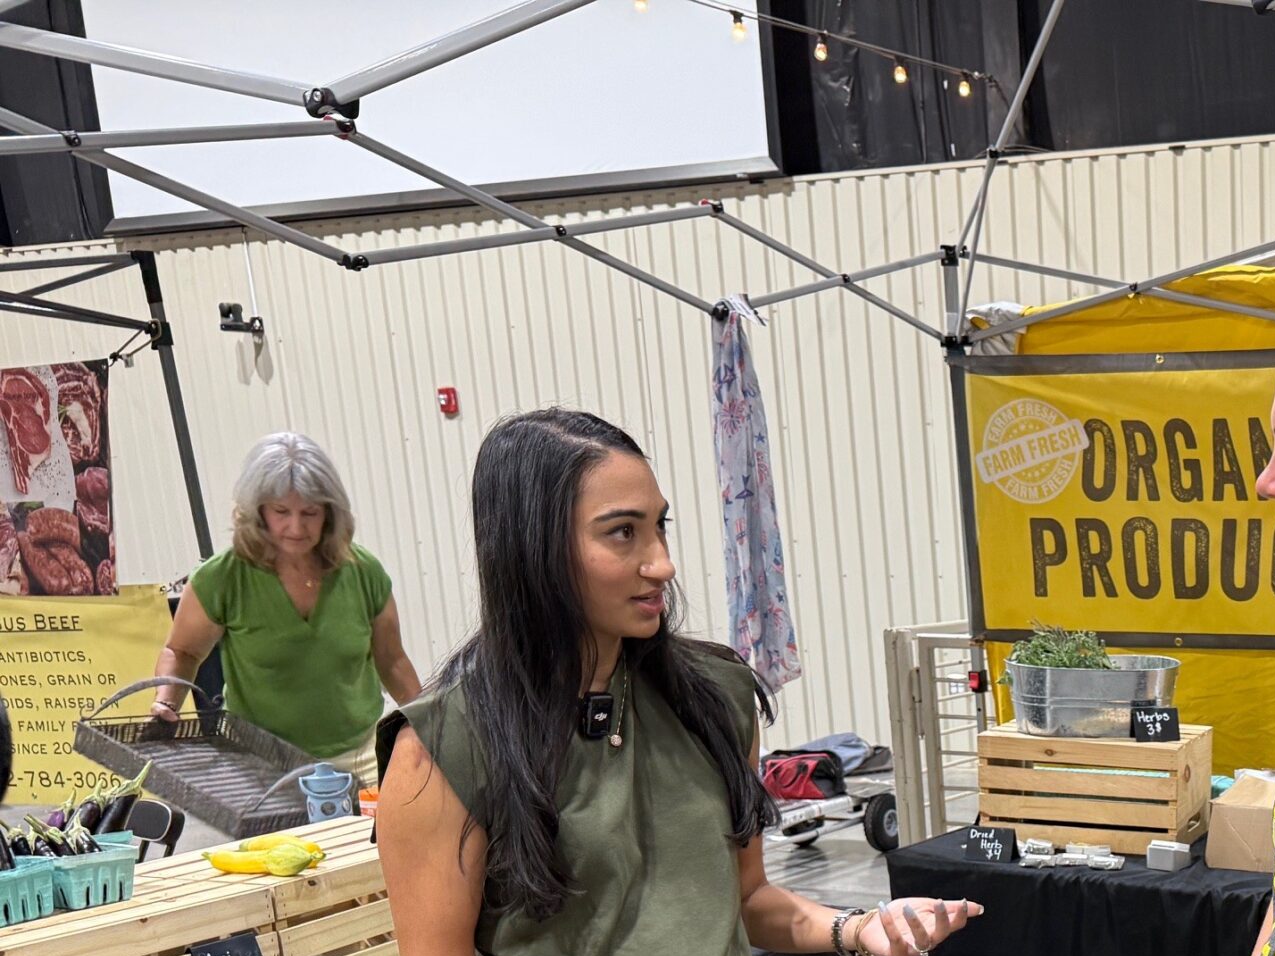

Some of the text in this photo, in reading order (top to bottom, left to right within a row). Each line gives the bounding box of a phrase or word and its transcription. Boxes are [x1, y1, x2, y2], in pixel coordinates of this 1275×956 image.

[983, 425, 1080, 478] FARM FRESH
[47, 674, 92, 686] GRAIN
[97, 673, 117, 686] OR
[44, 697, 95, 709] RAISED
[1136, 711, 1170, 722] Herbs
[18, 720, 66, 732] FAMILY
[970, 829, 996, 839] Dried
